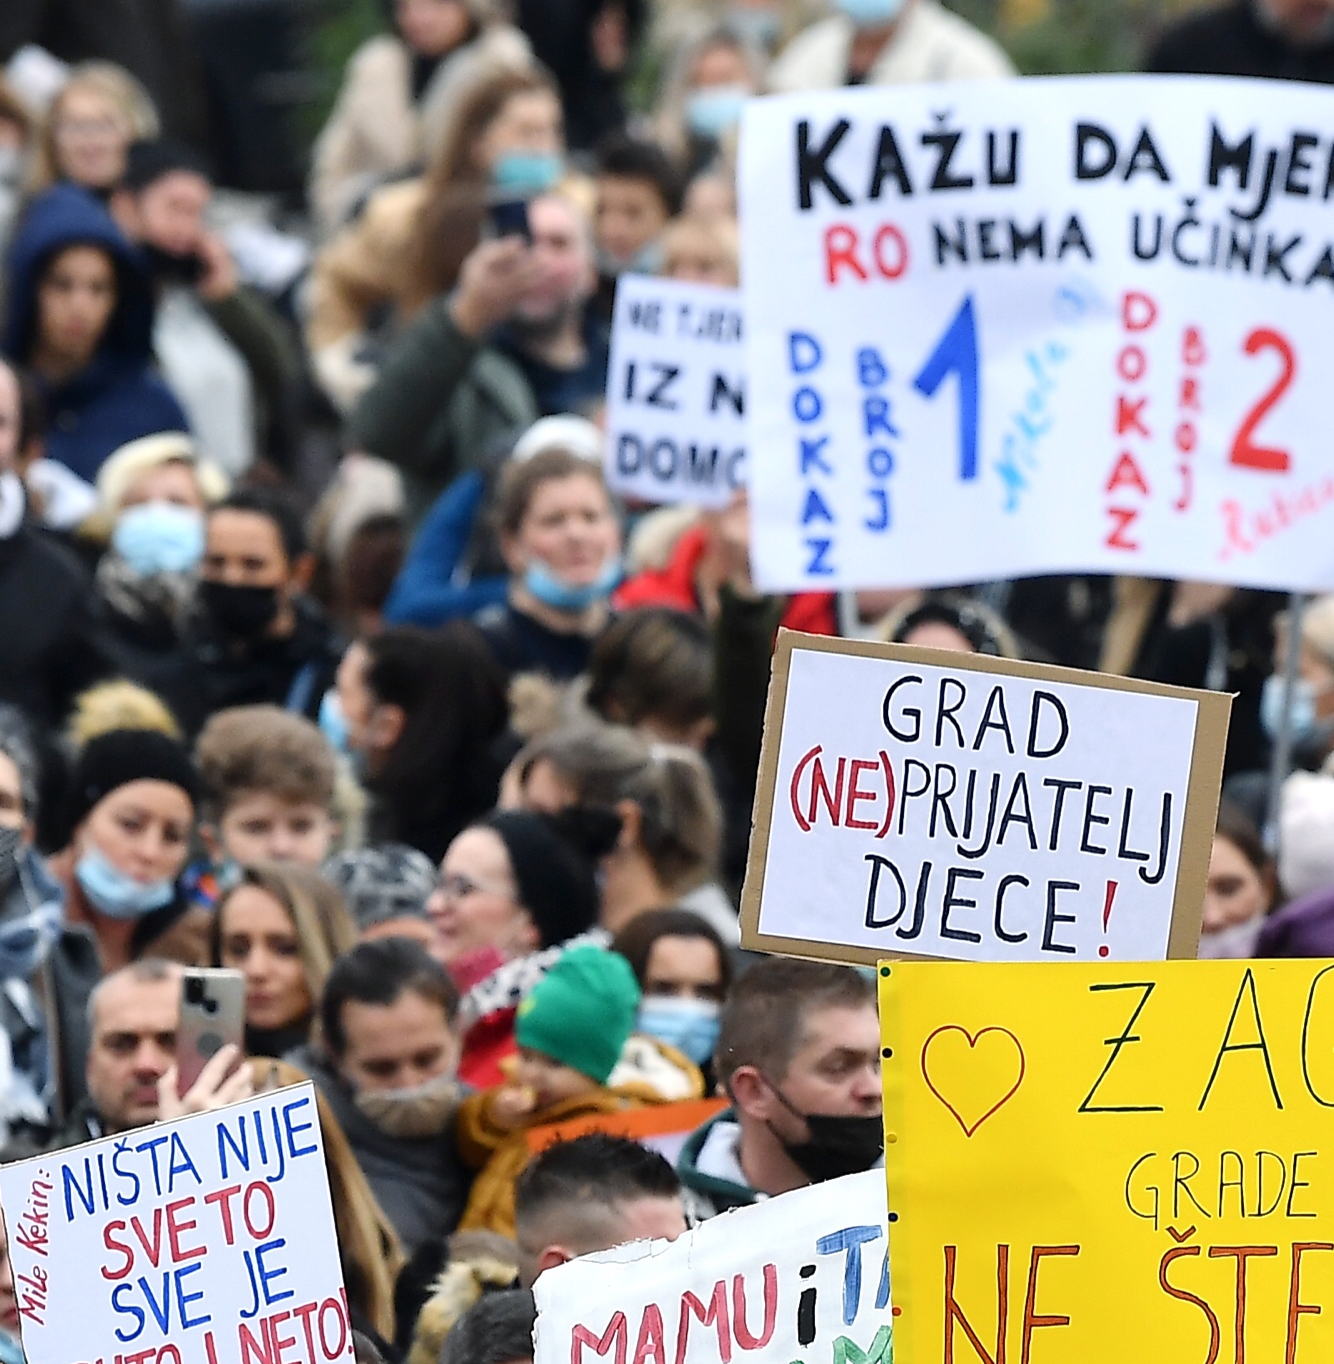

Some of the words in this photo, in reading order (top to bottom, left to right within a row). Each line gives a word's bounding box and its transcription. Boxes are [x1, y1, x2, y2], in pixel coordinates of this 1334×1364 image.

[795, 111, 1020, 208] KAŽU
[1074, 123, 1169, 182] DA
[823, 224, 908, 285] RO
[933, 215, 1094, 266] NEMA
[625, 363, 679, 411] IZ
[857, 348, 899, 532] BROJ
[912, 293, 979, 481] 1
[1104, 292, 1158, 551] DOKAZ
[1174, 327, 1205, 512] BROJ
[1228, 329, 1295, 473] 2
[788, 332, 836, 575] DOKAZ
[882, 675, 1069, 758] GRAD
[790, 745, 1173, 884] (NE)PRIJATELJ
[61, 1131, 202, 1221] NIŠTA
[217, 1098, 318, 1183] NIJE
[1126, 1150, 1318, 1231] GRADE
[101, 1196, 207, 1280] SVE
[204, 1180, 275, 1245] TO
[111, 1262, 211, 1342] SVE
[239, 1238, 295, 1319] JE
